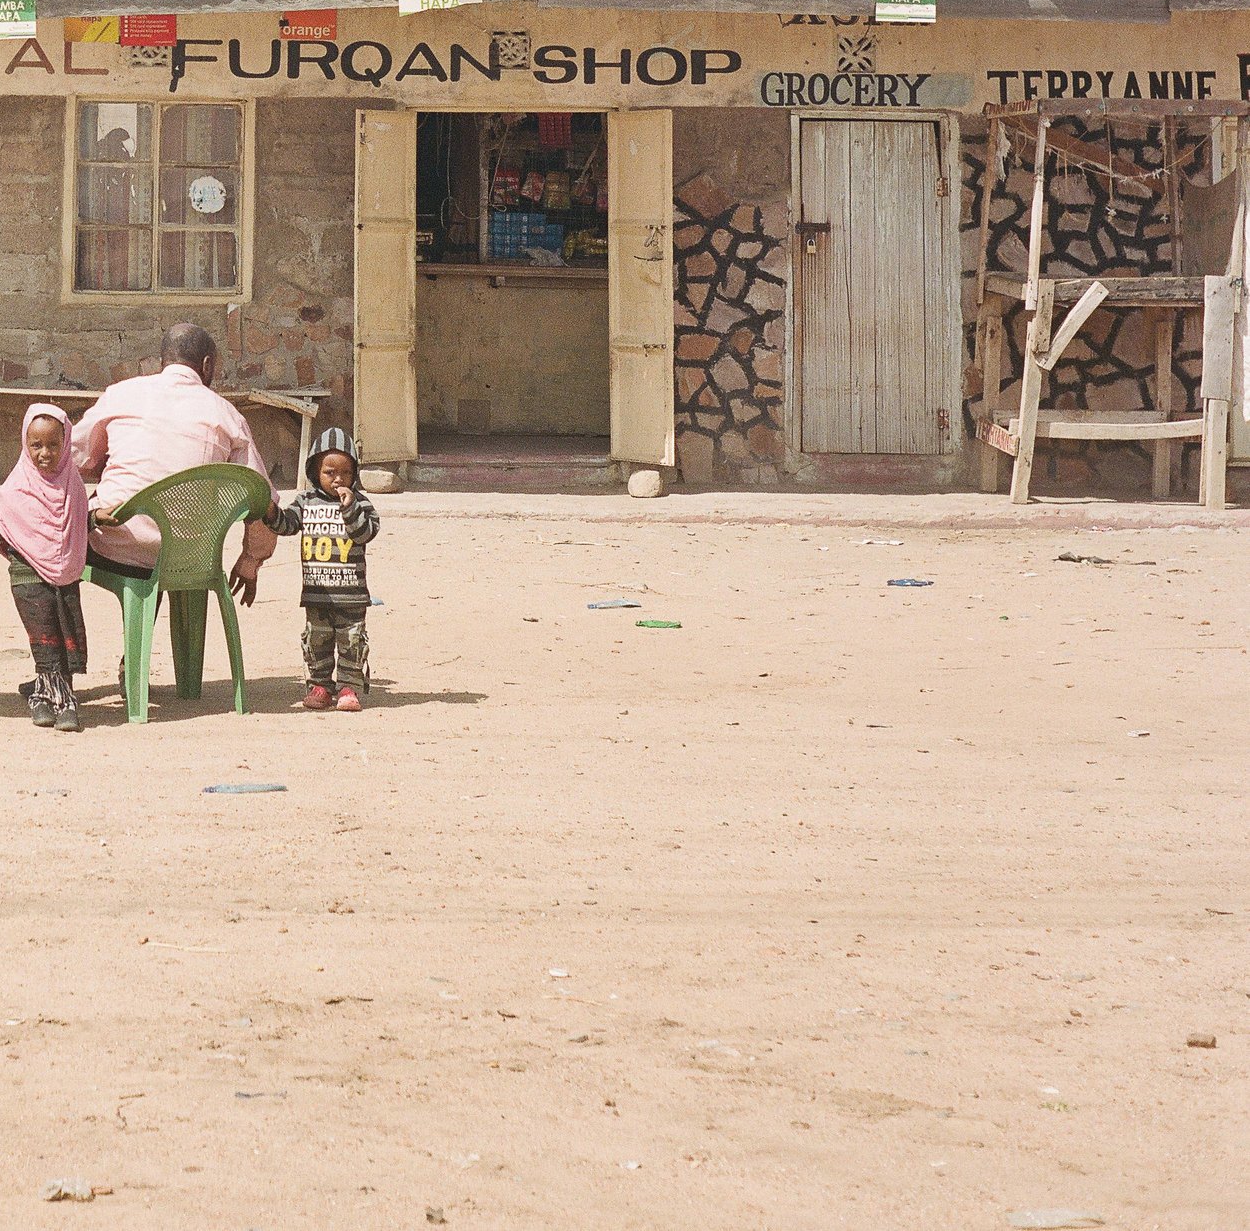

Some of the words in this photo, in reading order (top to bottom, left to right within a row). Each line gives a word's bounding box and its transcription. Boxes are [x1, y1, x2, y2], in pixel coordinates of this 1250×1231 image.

[282, 25, 331, 39] orange
[4, 37, 110, 76] AL
[168, 38, 500, 89] FURQAN
[533, 45, 743, 86] SHOP
[760, 71, 932, 108] GROCERY
[303, 523, 347, 536] XIAOBU
[302, 536, 354, 564] BOY
